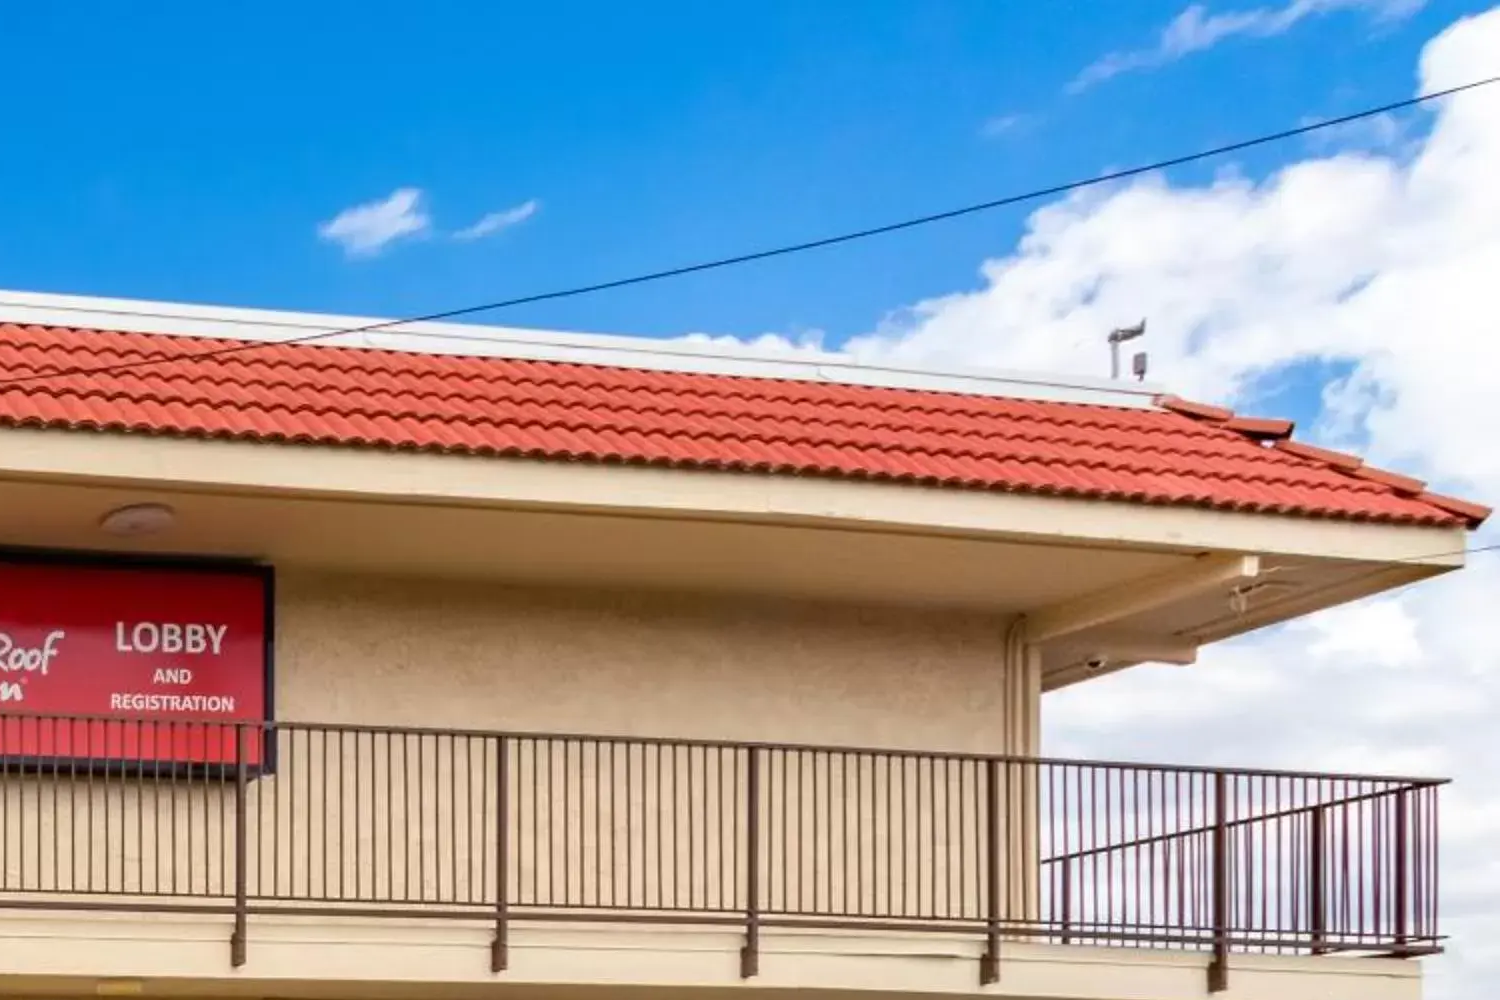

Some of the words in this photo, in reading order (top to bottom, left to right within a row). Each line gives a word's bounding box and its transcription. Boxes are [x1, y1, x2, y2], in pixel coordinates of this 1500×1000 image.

[116, 621, 228, 655] LOBBY
[153, 668, 192, 685] AND
[111, 693, 235, 712] REGISTRATION
